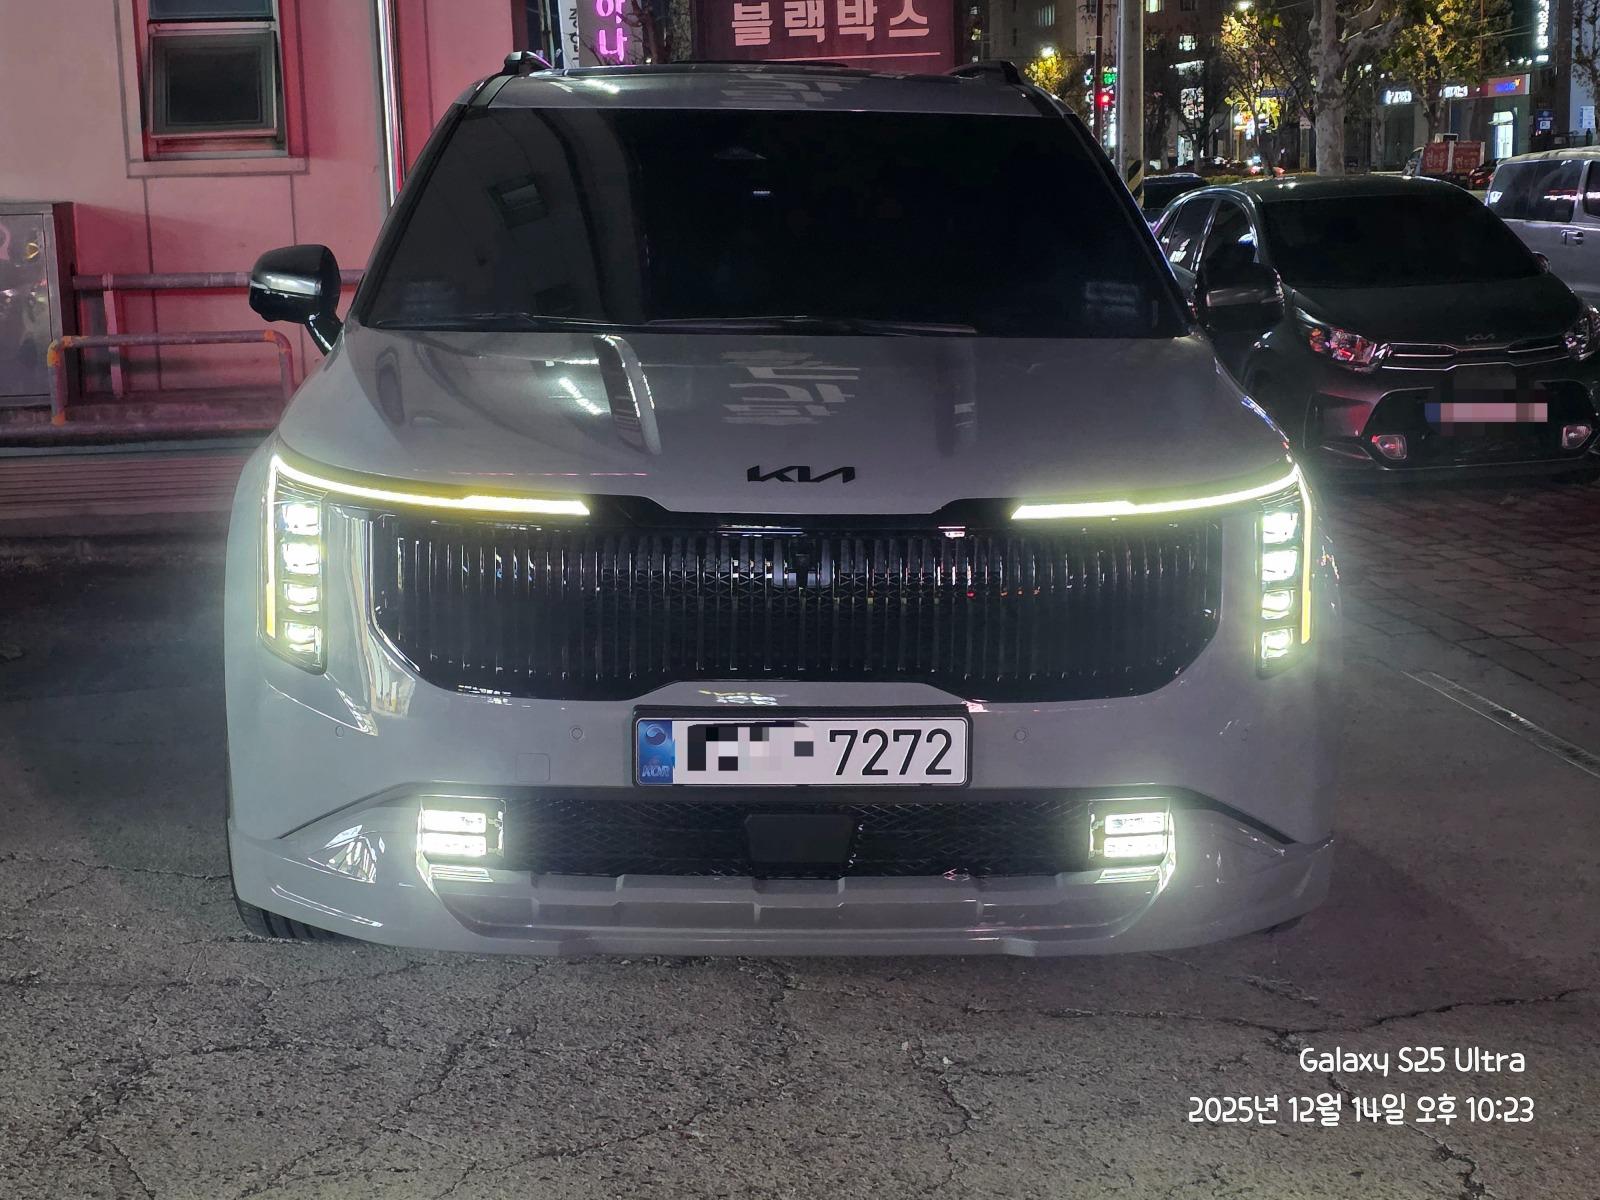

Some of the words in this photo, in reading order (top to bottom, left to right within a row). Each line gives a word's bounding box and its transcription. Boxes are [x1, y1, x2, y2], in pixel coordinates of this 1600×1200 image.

[731, 0, 930, 46] 블랙박스
[747, 465, 856, 484] KIA
[829, 728, 952, 776] 7272
